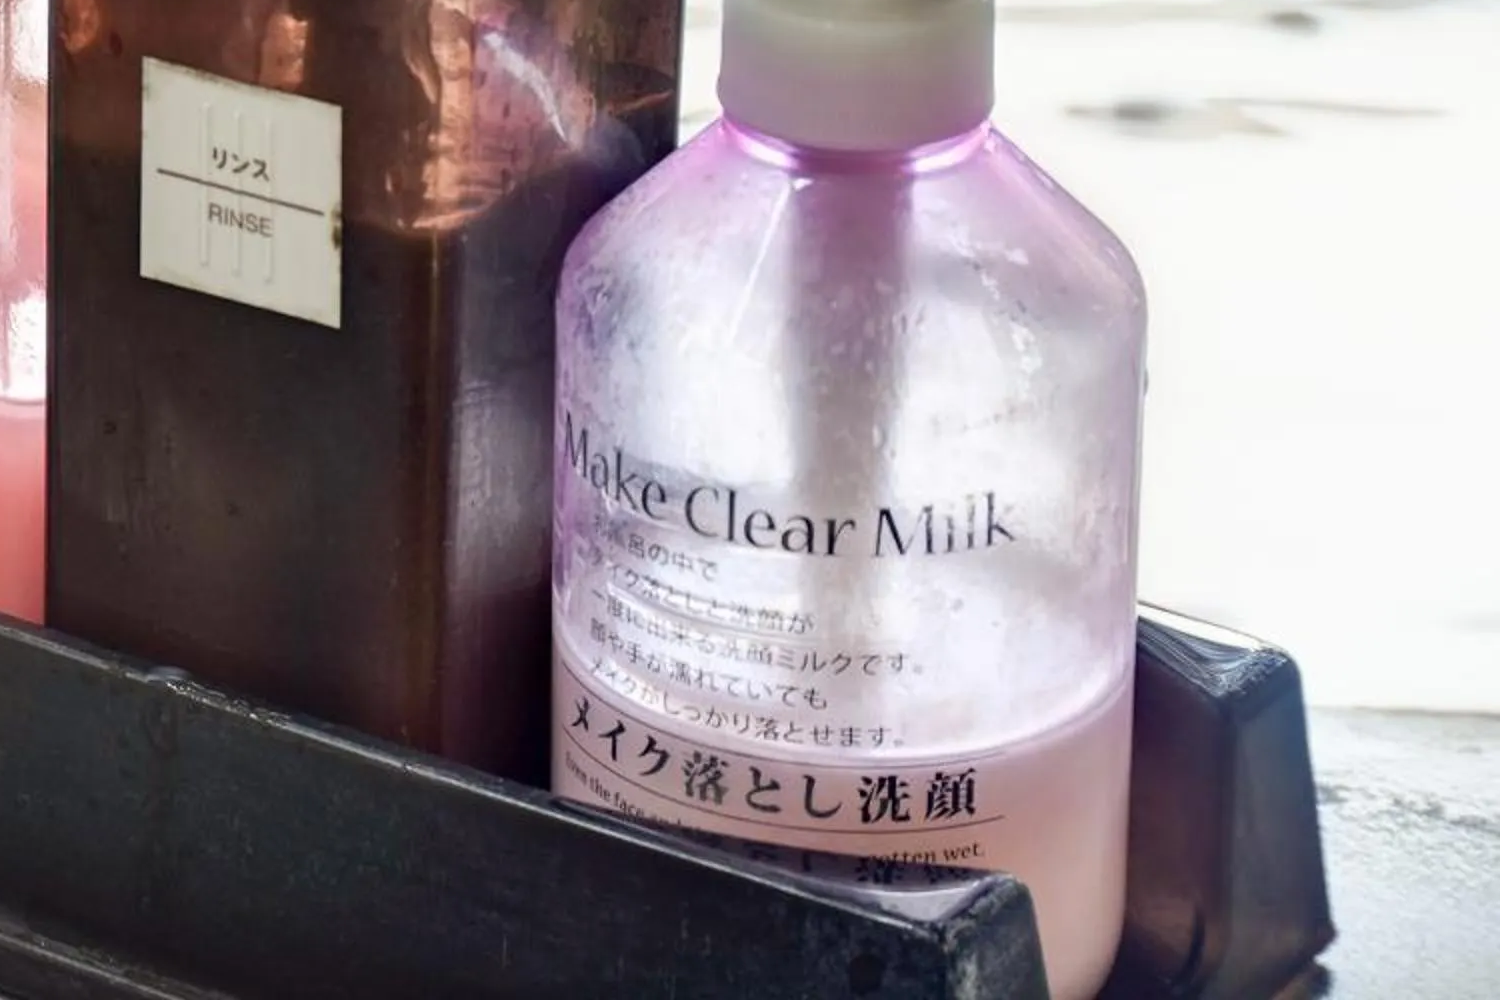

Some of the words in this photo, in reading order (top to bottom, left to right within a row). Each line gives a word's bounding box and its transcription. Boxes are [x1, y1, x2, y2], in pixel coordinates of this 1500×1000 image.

[212, 147, 270, 182] リンス
[208, 202, 274, 238] RINSE
[564, 410, 667, 521] Make
[684, 485, 856, 556] Clear
[874, 491, 1016, 558] Milk
[591, 511, 718, 582] 呂の中で
[570, 695, 978, 825] メイク落とし洗顔
